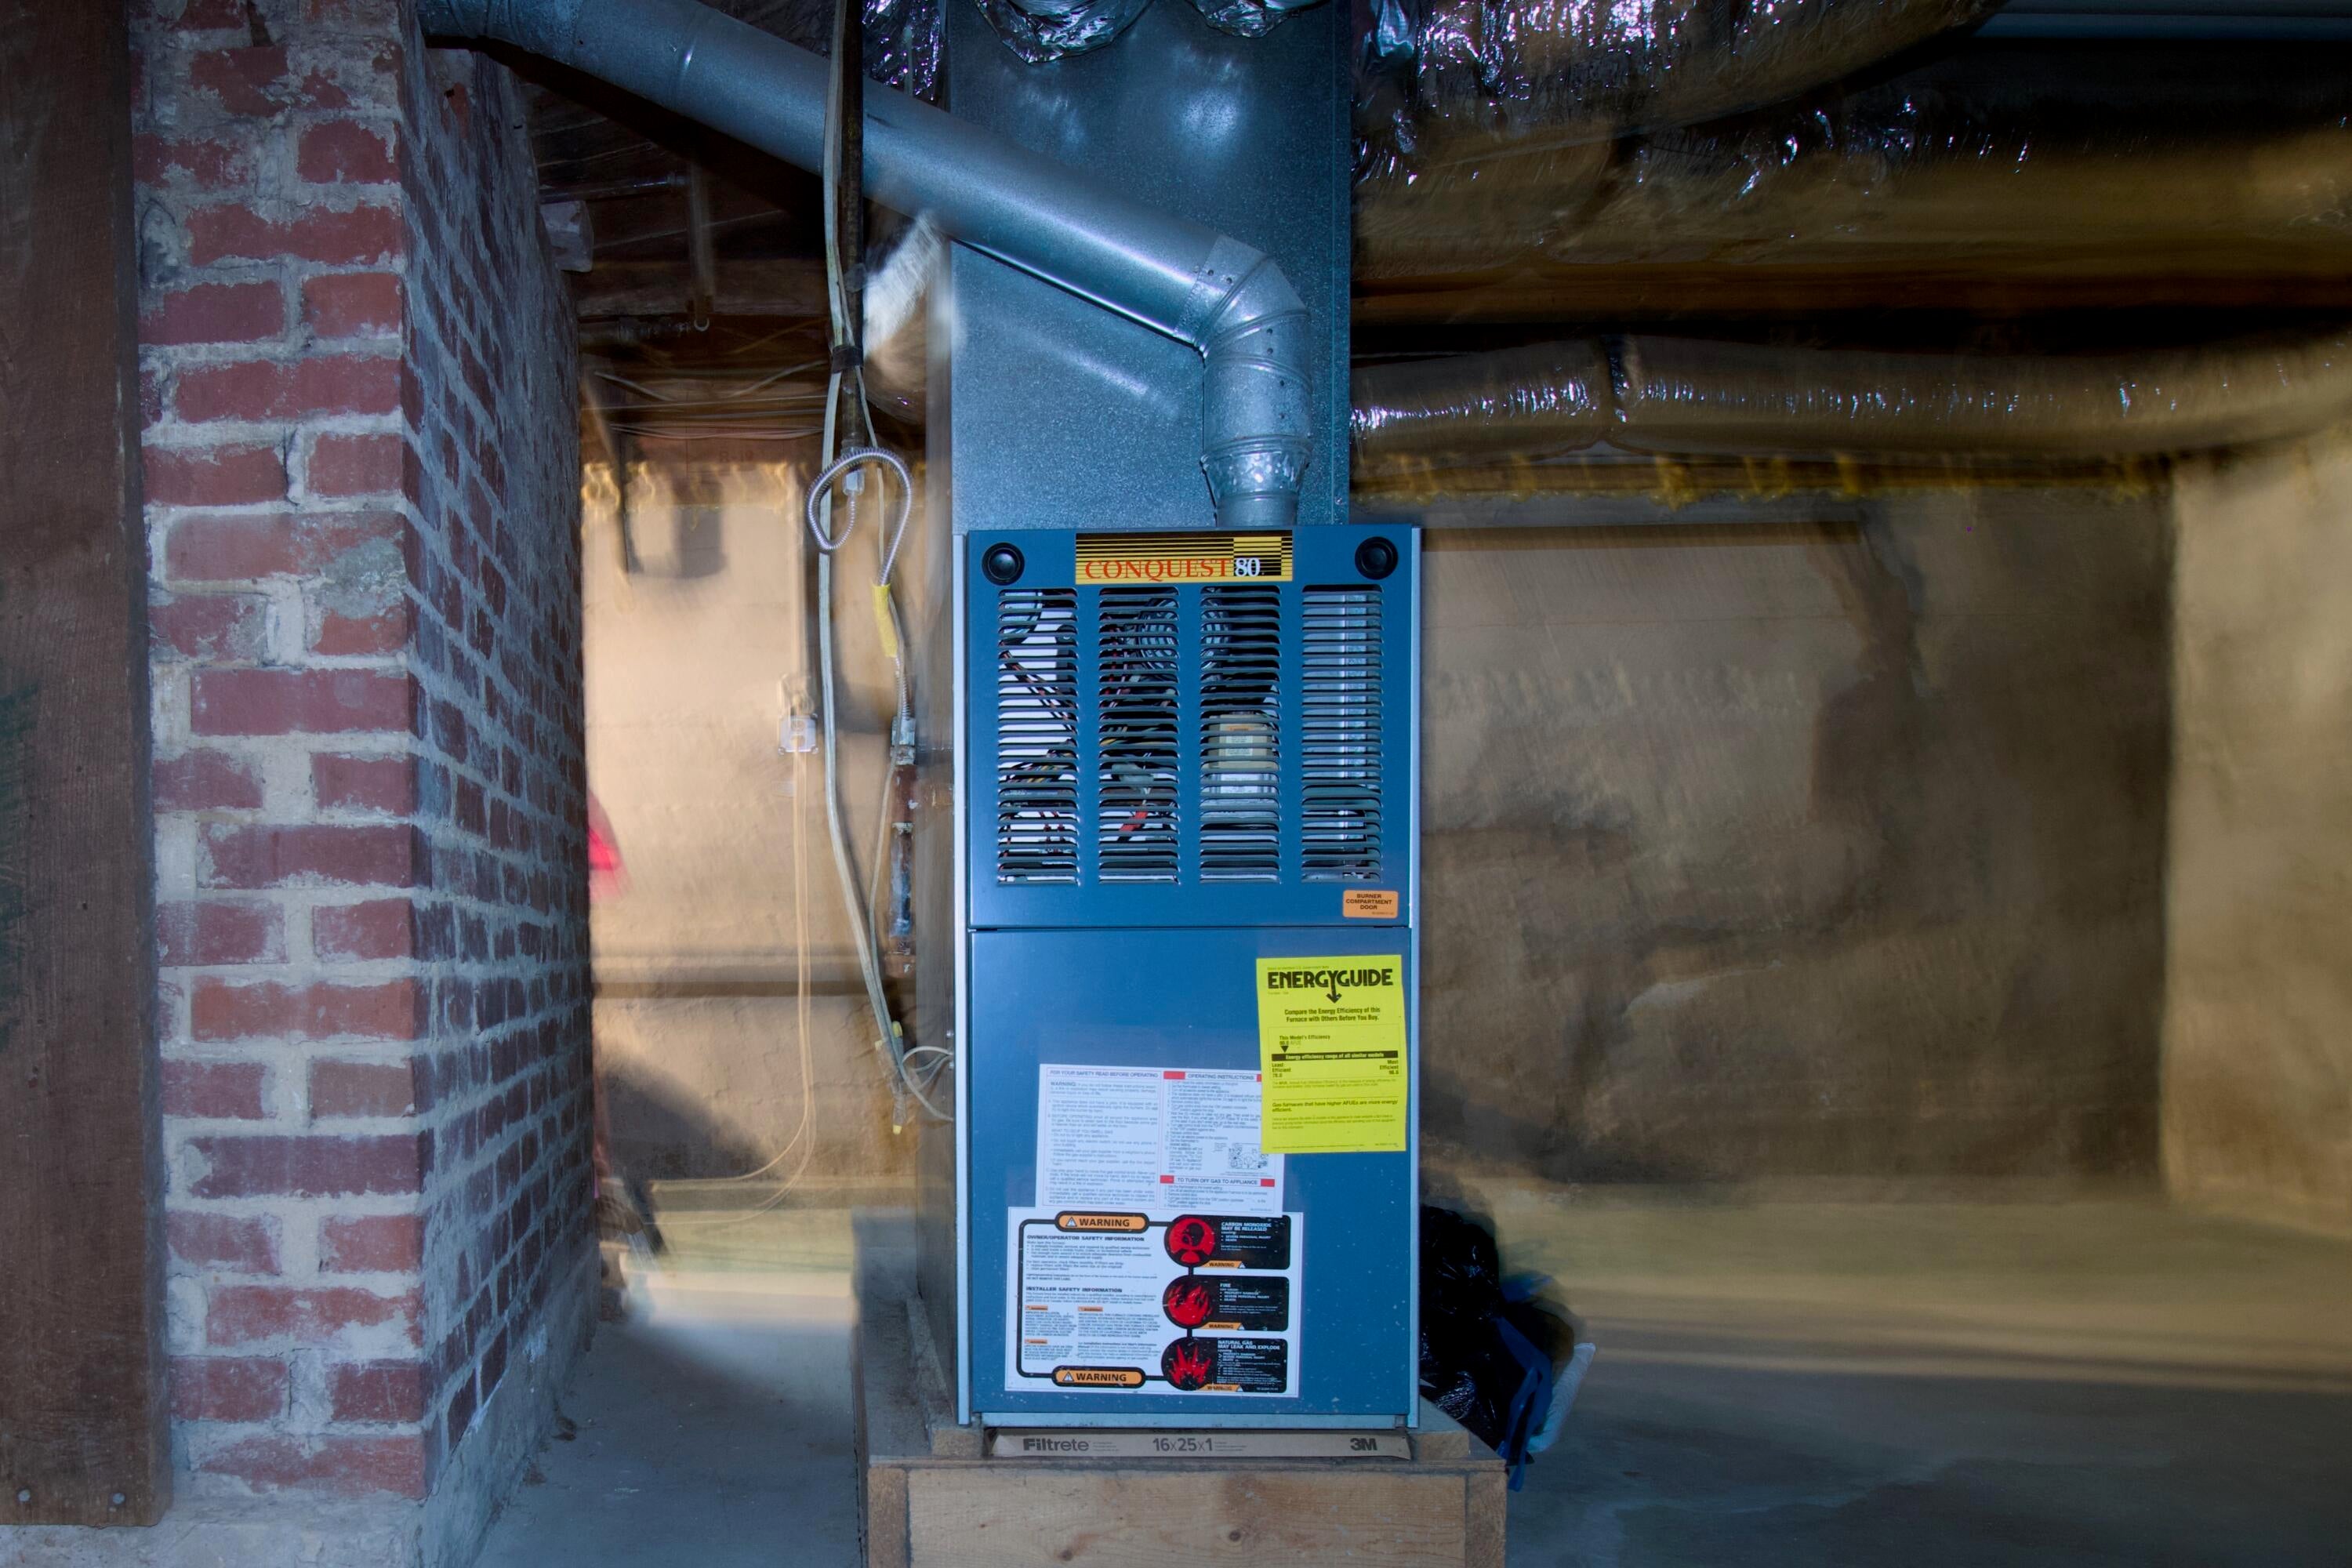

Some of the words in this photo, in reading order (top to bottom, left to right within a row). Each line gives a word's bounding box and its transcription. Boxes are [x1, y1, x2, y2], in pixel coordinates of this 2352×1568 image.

[1085, 557, 1233, 582] CONQUEST
[1234, 557, 1261, 578] 80
[1267, 968, 1394, 989] ENERGYGUIDE
[1079, 1218, 1130, 1227] WARNING
[1076, 1373, 1127, 1381] WARNING
[1023, 1438, 1089, 1451] Filtrete
[1152, 1438, 1213, 1451] 16x25x1
[1350, 1438, 1377, 1450] 3M
